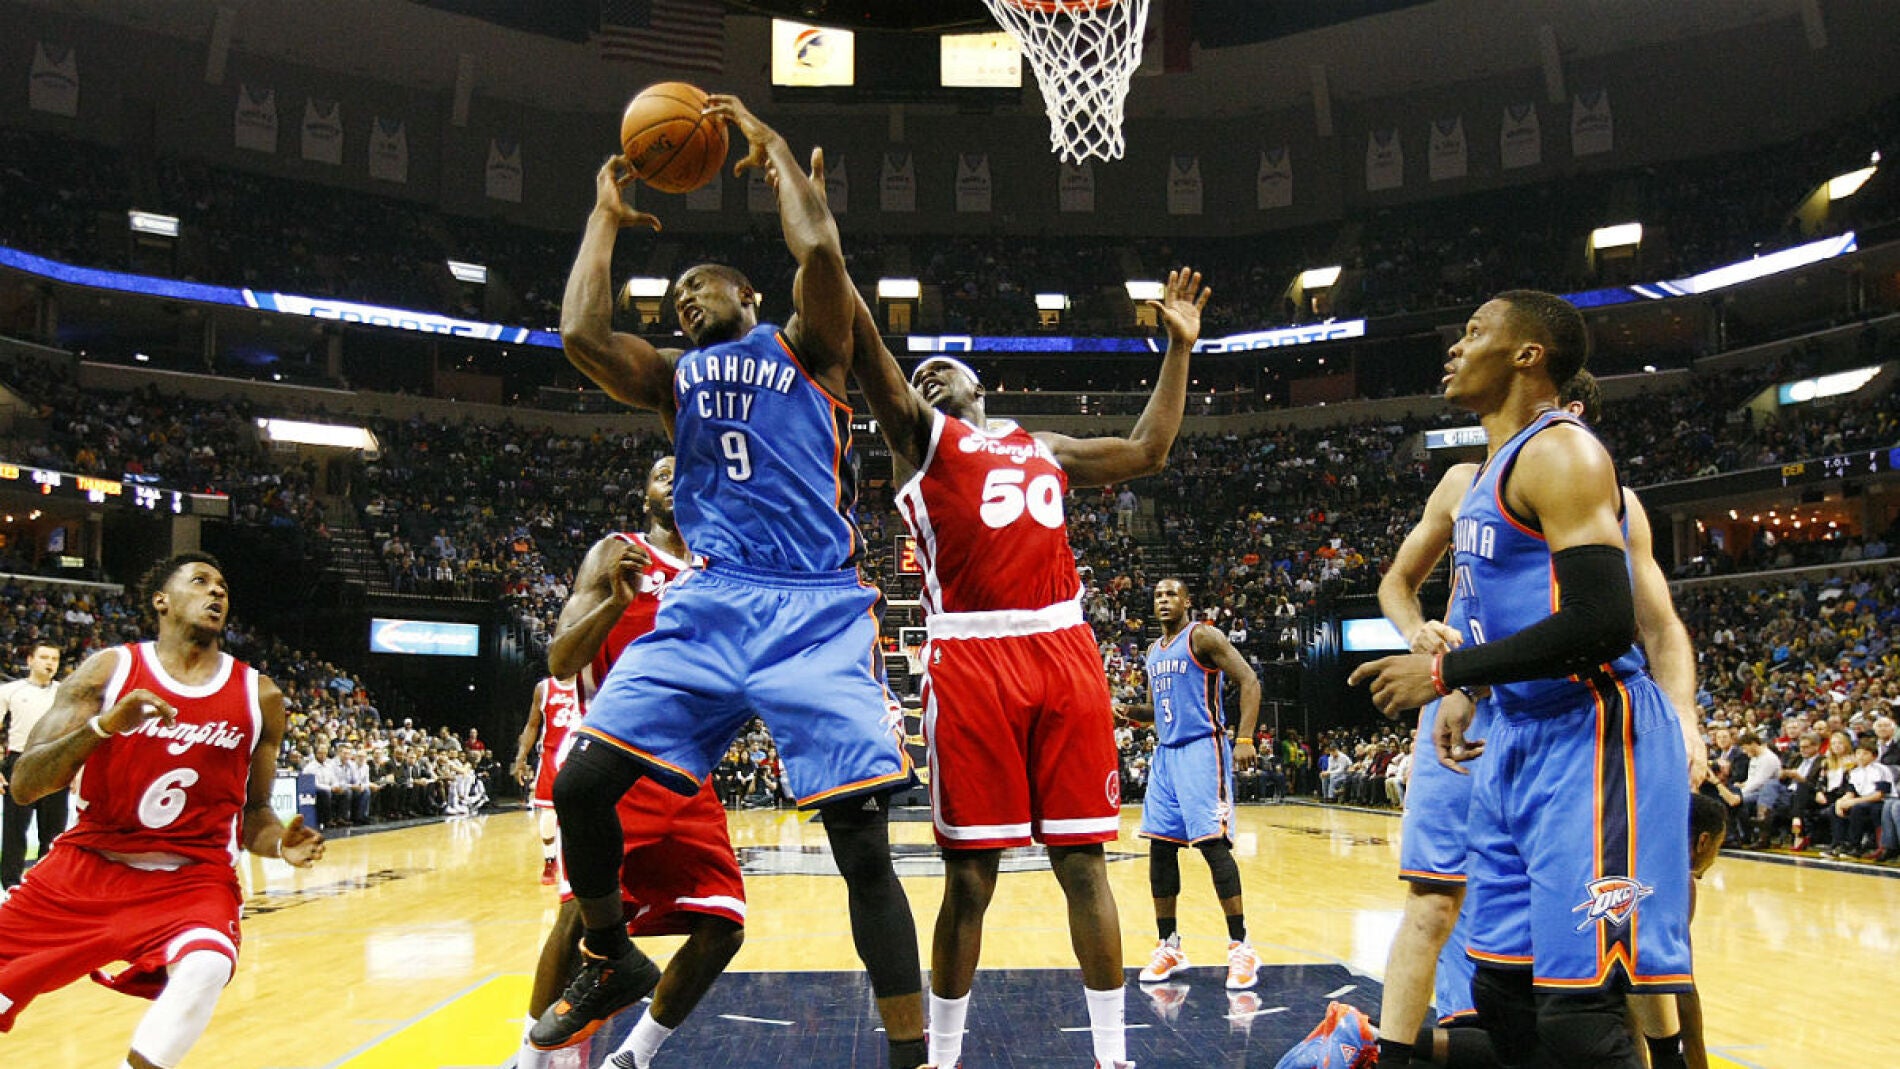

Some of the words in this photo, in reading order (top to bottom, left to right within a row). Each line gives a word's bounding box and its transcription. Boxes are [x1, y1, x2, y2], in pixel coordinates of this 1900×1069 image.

[696, 390, 754, 421] CITY
[720, 431, 753, 482] 9
[979, 468, 1065, 529] 50
[1161, 697, 1173, 723] 3
[137, 766, 200, 829] 6
